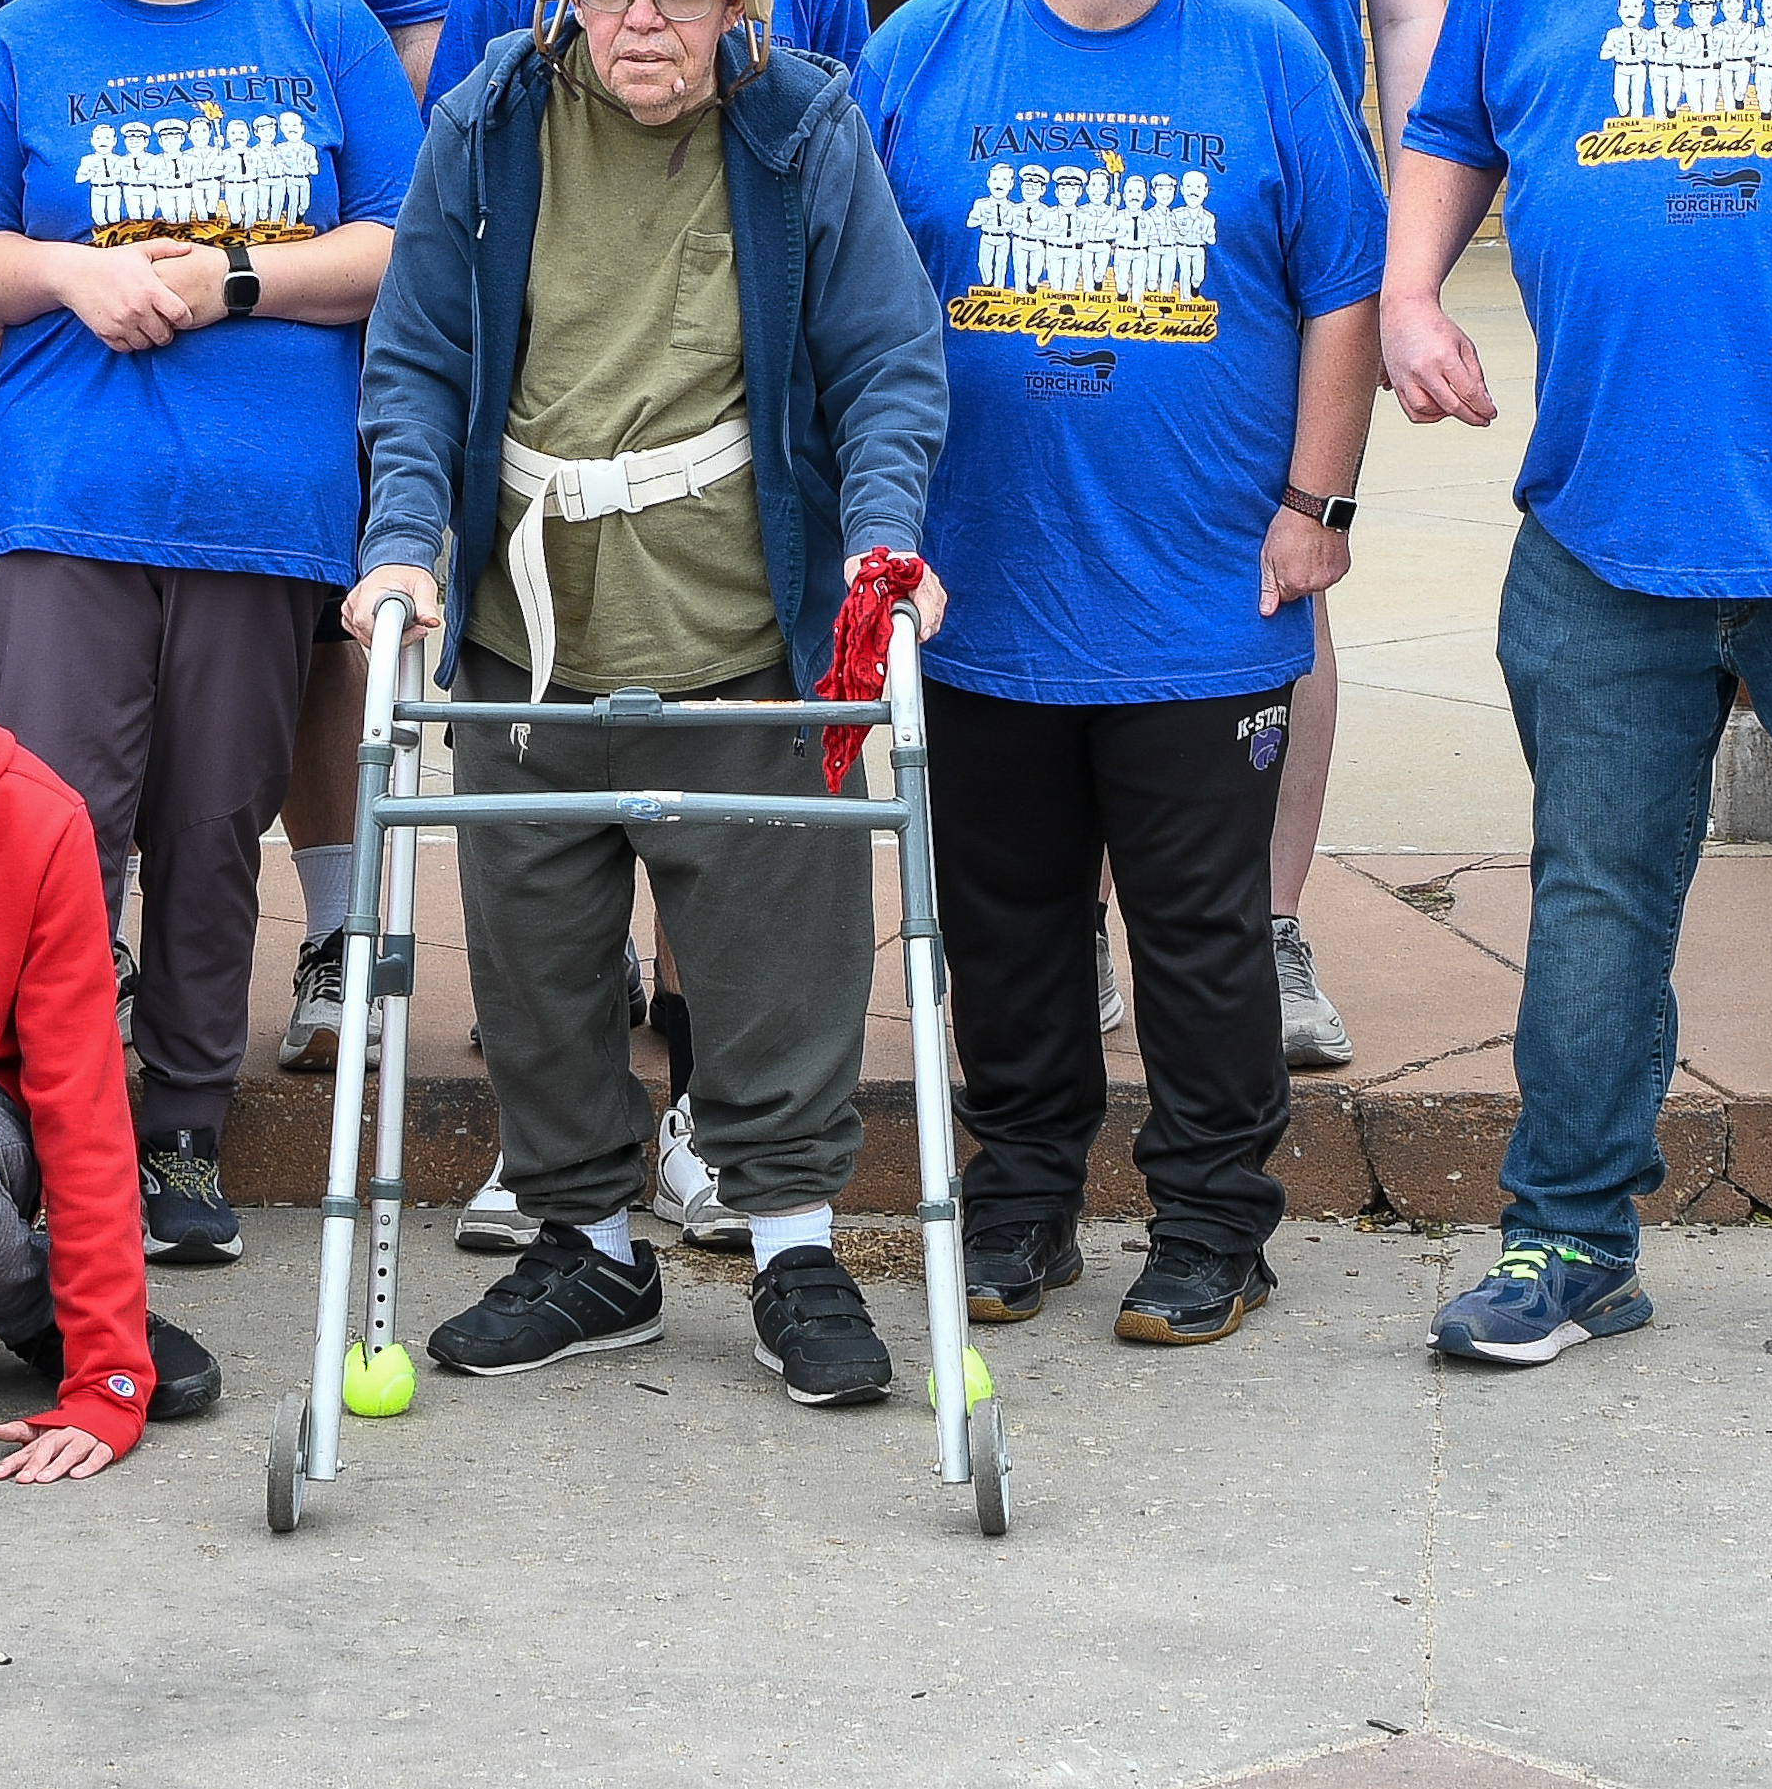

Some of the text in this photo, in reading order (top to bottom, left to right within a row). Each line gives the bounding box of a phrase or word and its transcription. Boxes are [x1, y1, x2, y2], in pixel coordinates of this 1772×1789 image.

[145, 65, 259, 84] ANNIVERSARY
[68, 77, 318, 126] KANSAS LETR
[1054, 112, 1171, 127] ANNIVERSARY
[1730, 113, 1755, 123] MILES
[1652, 121, 1678, 132] IPSEN
[969, 125, 1227, 174] KANSAS LETR
[1581, 134, 1663, 162] Where
[1667, 129, 1754, 164] legends
[1665, 199, 1757, 213] TORCH RUN
[1013, 296, 1037, 306] IPSEN
[1088, 293, 1112, 304] MILES
[950, 300, 1215, 340] Where legends are made
[1024, 376, 1113, 393] TORCH RUN
